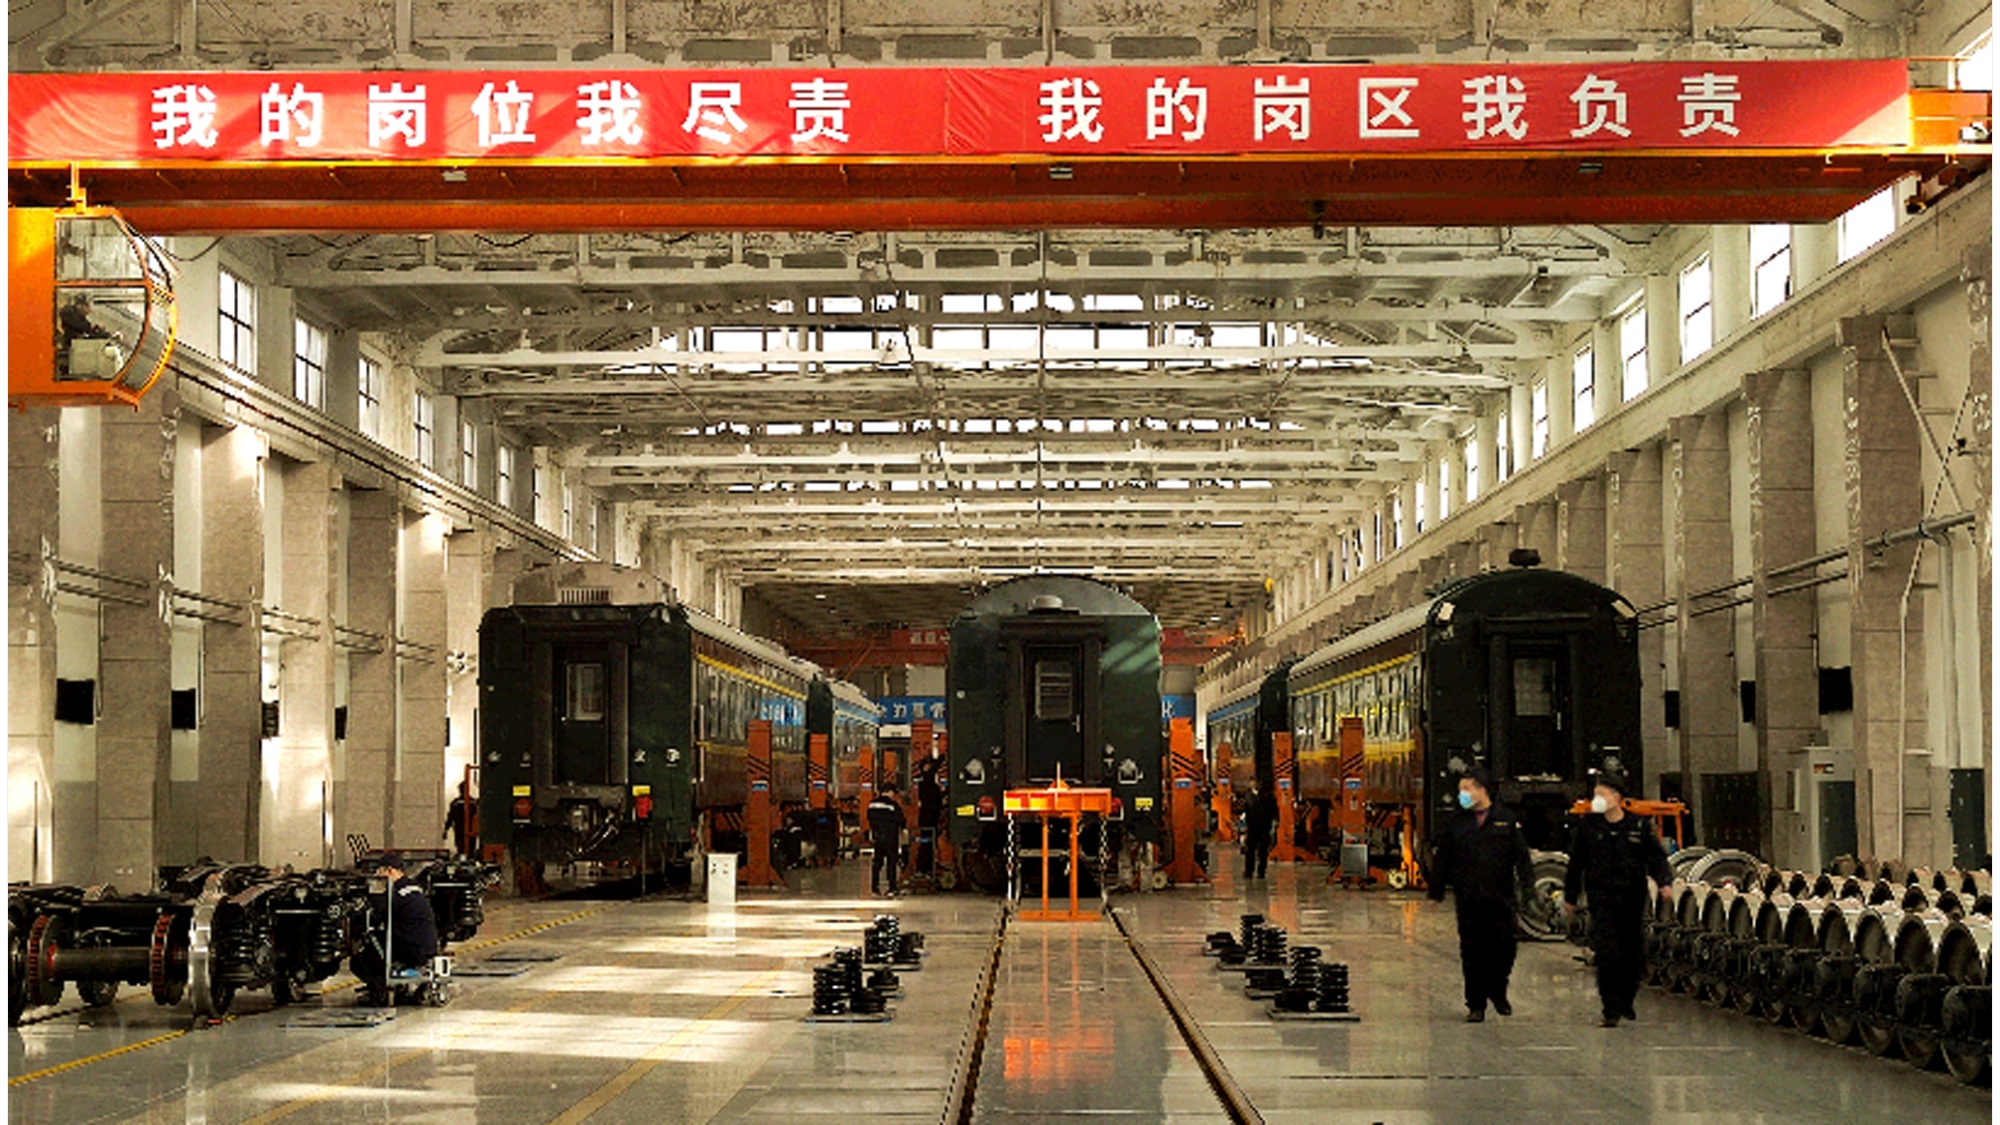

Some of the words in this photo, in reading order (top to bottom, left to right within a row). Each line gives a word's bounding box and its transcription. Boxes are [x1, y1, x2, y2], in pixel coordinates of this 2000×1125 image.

[151, 77, 853, 149] 我的岗位我尽责
[1038, 72, 1743, 143] 我的岗区我负责
